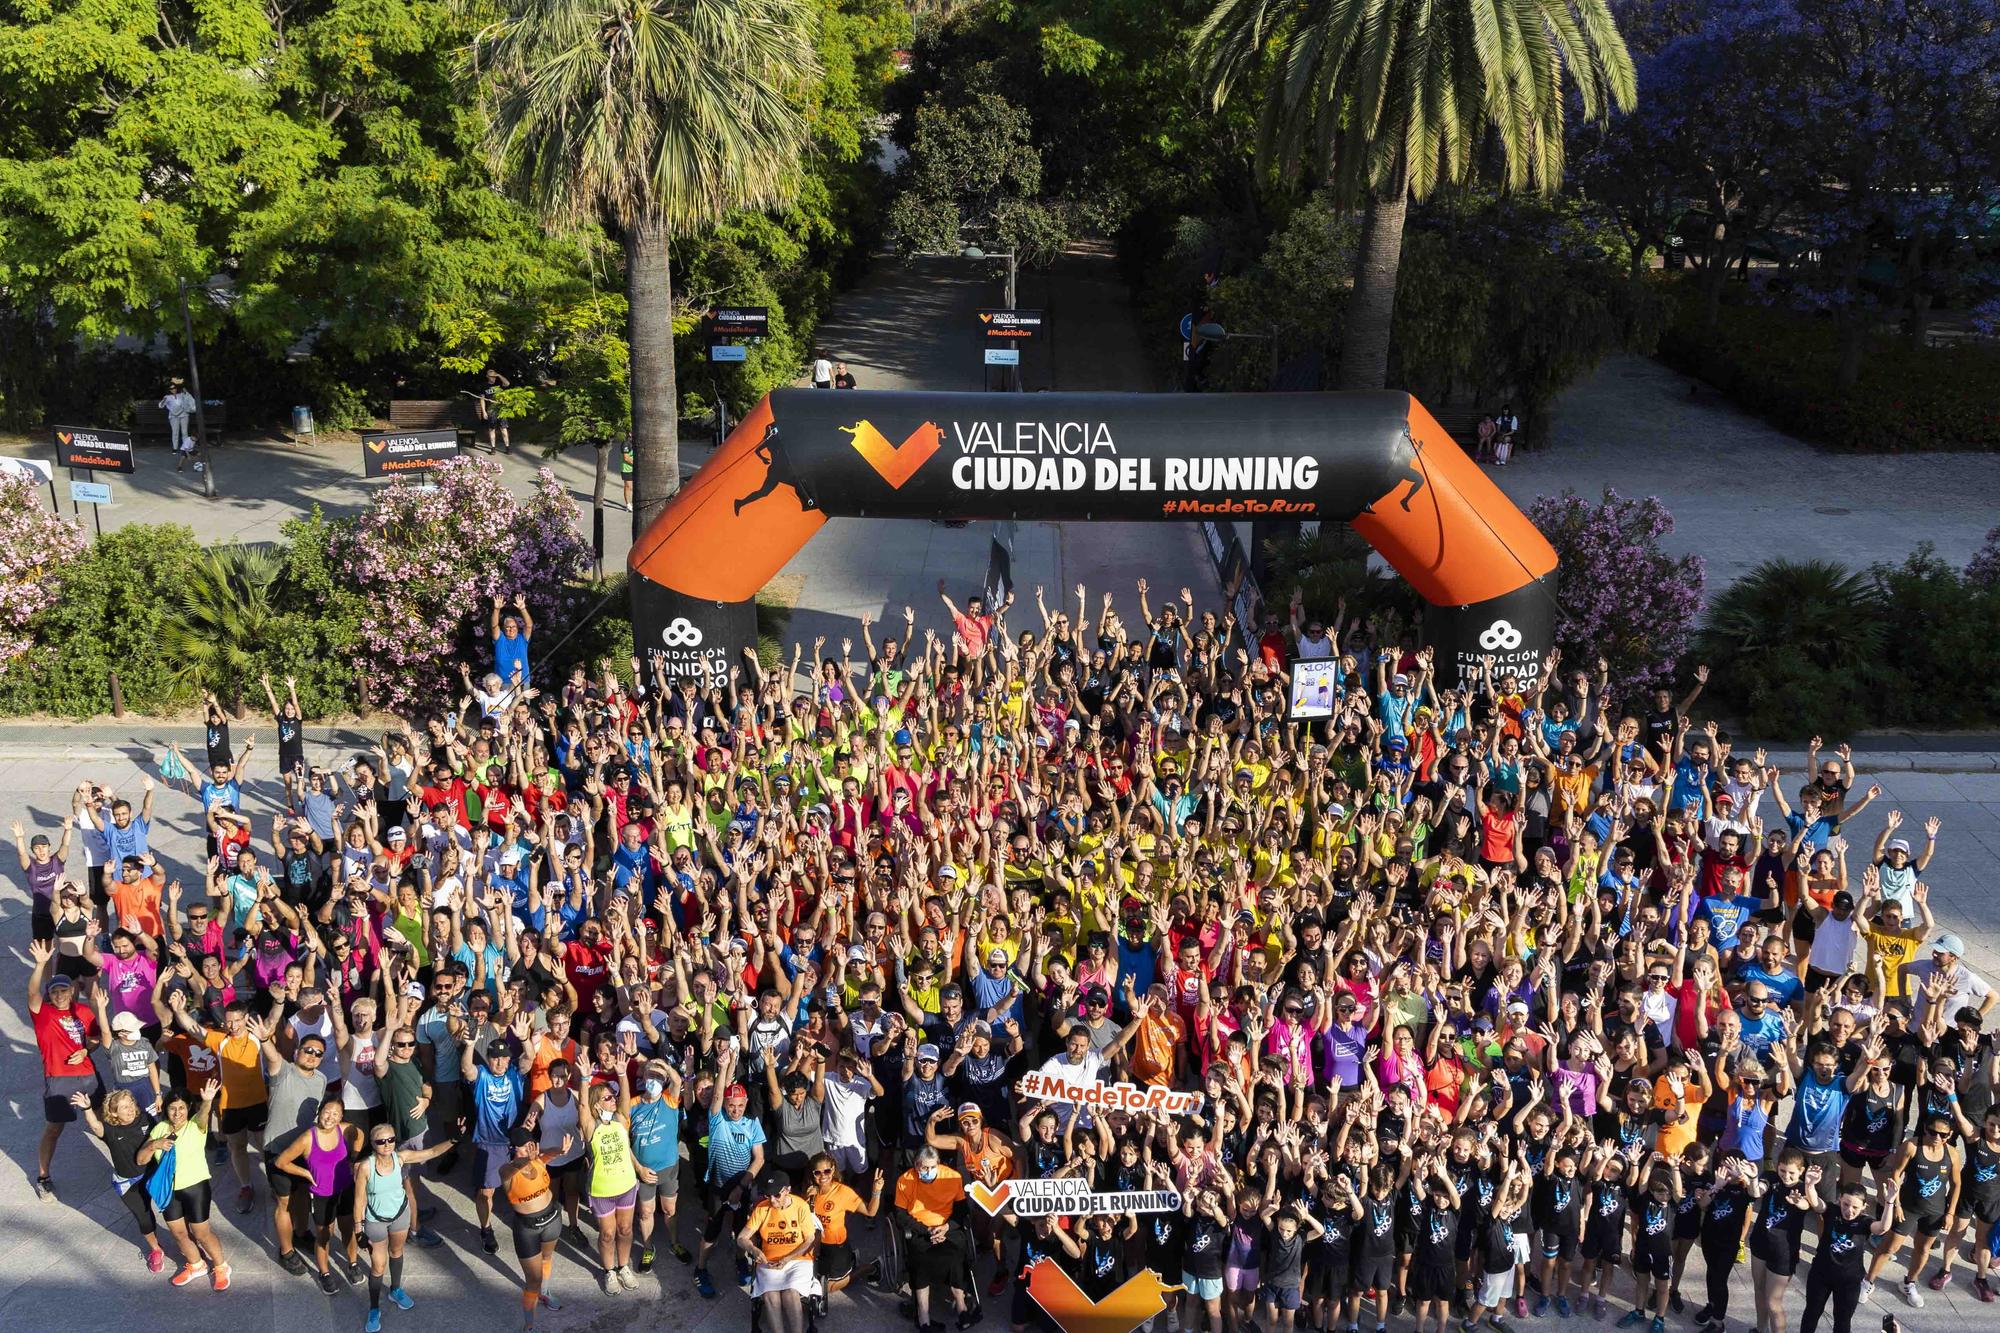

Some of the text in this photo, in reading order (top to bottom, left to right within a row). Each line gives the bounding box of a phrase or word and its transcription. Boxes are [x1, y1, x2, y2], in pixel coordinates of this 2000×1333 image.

[987, 329, 1032, 337] #MadeToRun
[73, 433, 98, 442] VALENCIA
[386, 438, 420, 446] VALENCIA
[953, 421, 1117, 455] VALENCIA
[74, 440, 95, 449] CIUDAD
[104, 443, 129, 451] RUNNING
[388, 440, 457, 453] CIUDAD DEL RUNNING
[69, 454, 121, 467] #MadeToRun
[951, 455, 1319, 491] CIUDAD DEL RUNNING
[1162, 499, 1316, 514] #MadeToRun
[648, 647, 726, 660] FUNDACIÓN
[1306, 662, 1333, 672] 10K
[1025, 1074, 1201, 1111] #MadeToRun
[1867, 1118, 1887, 1133] 3FDC
[1014, 1180, 1089, 1196] VALENCIA
[1016, 1193, 1178, 1213] CIUDAD DEL RUNNING
[1600, 1200, 1618, 1216] 3FDC
[1646, 1218, 1666, 1236] 3FDC
